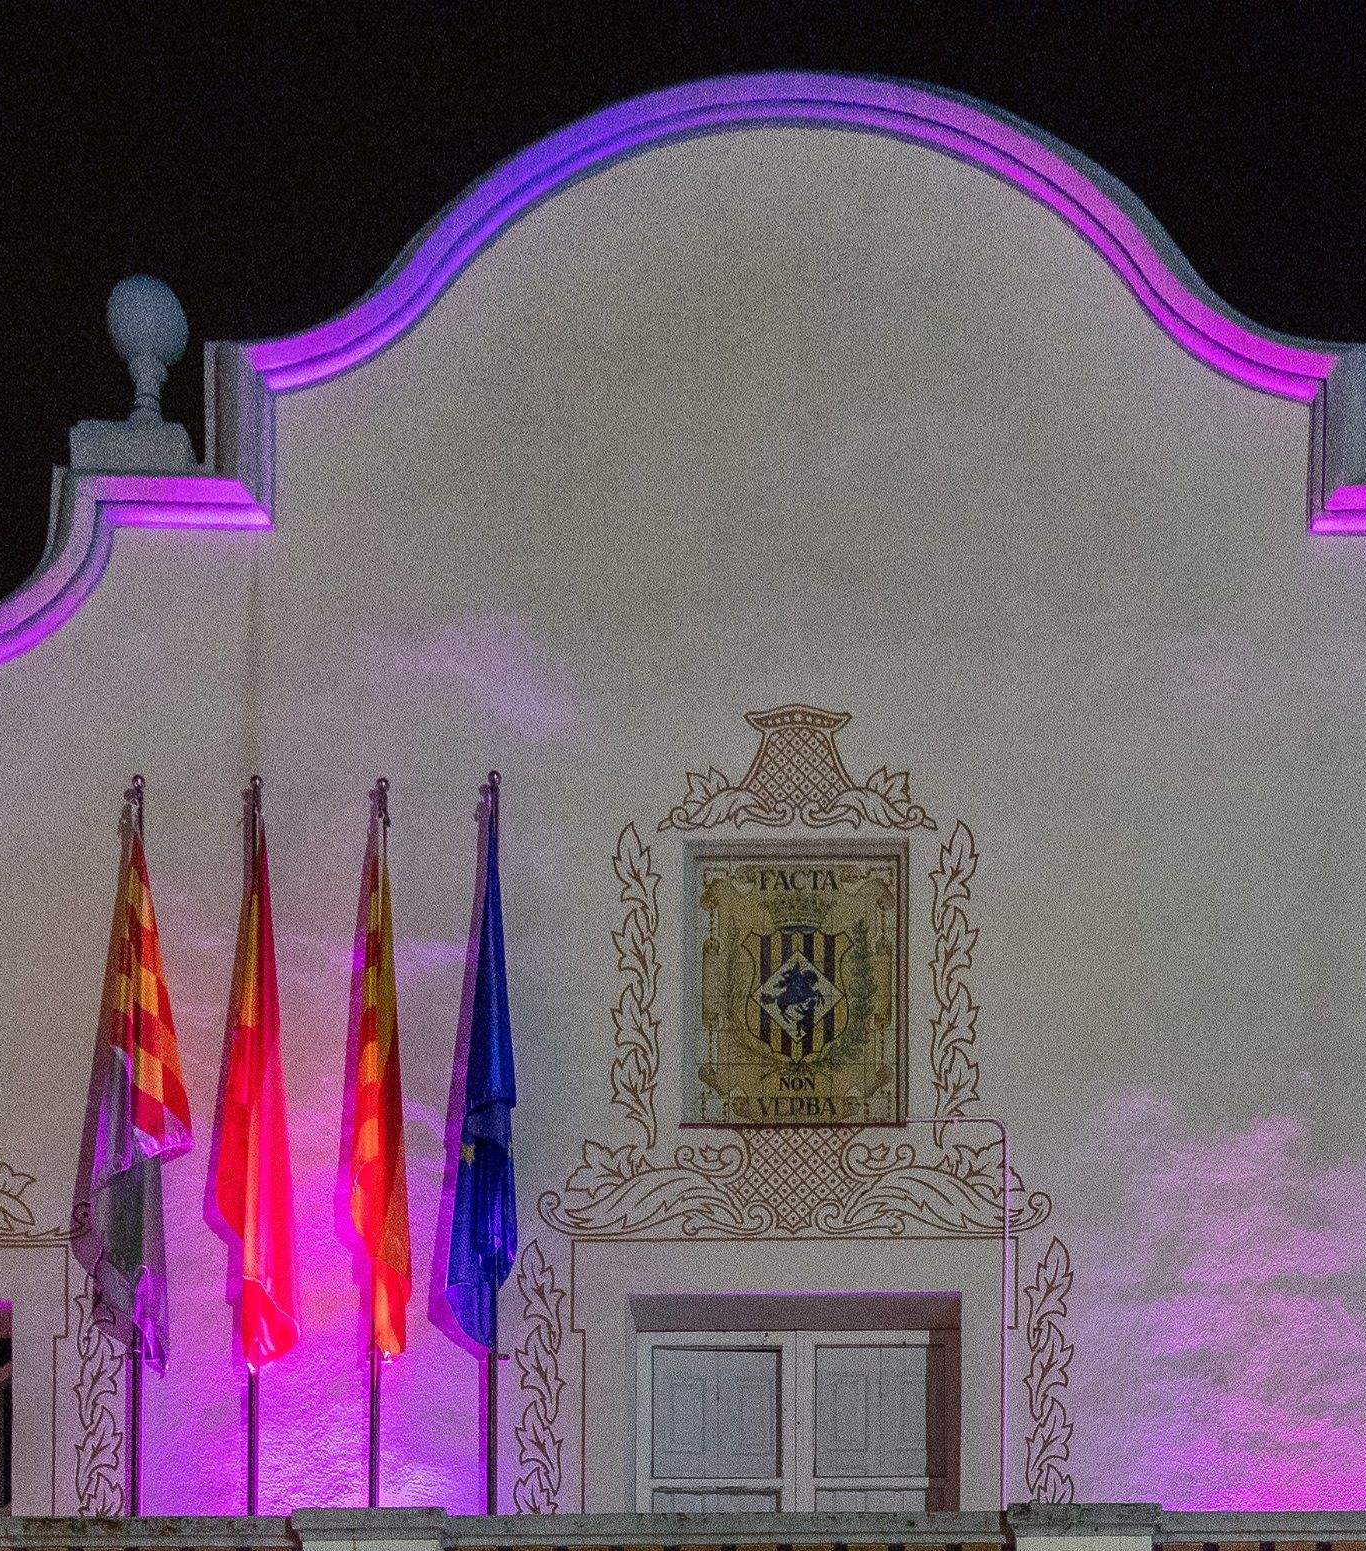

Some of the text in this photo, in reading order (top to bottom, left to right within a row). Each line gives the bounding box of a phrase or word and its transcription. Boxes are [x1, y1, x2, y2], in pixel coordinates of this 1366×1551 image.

[758, 869, 838, 891] FACTA
[779, 1076, 816, 1091] NON
[757, 1096, 837, 1117] VERBA
